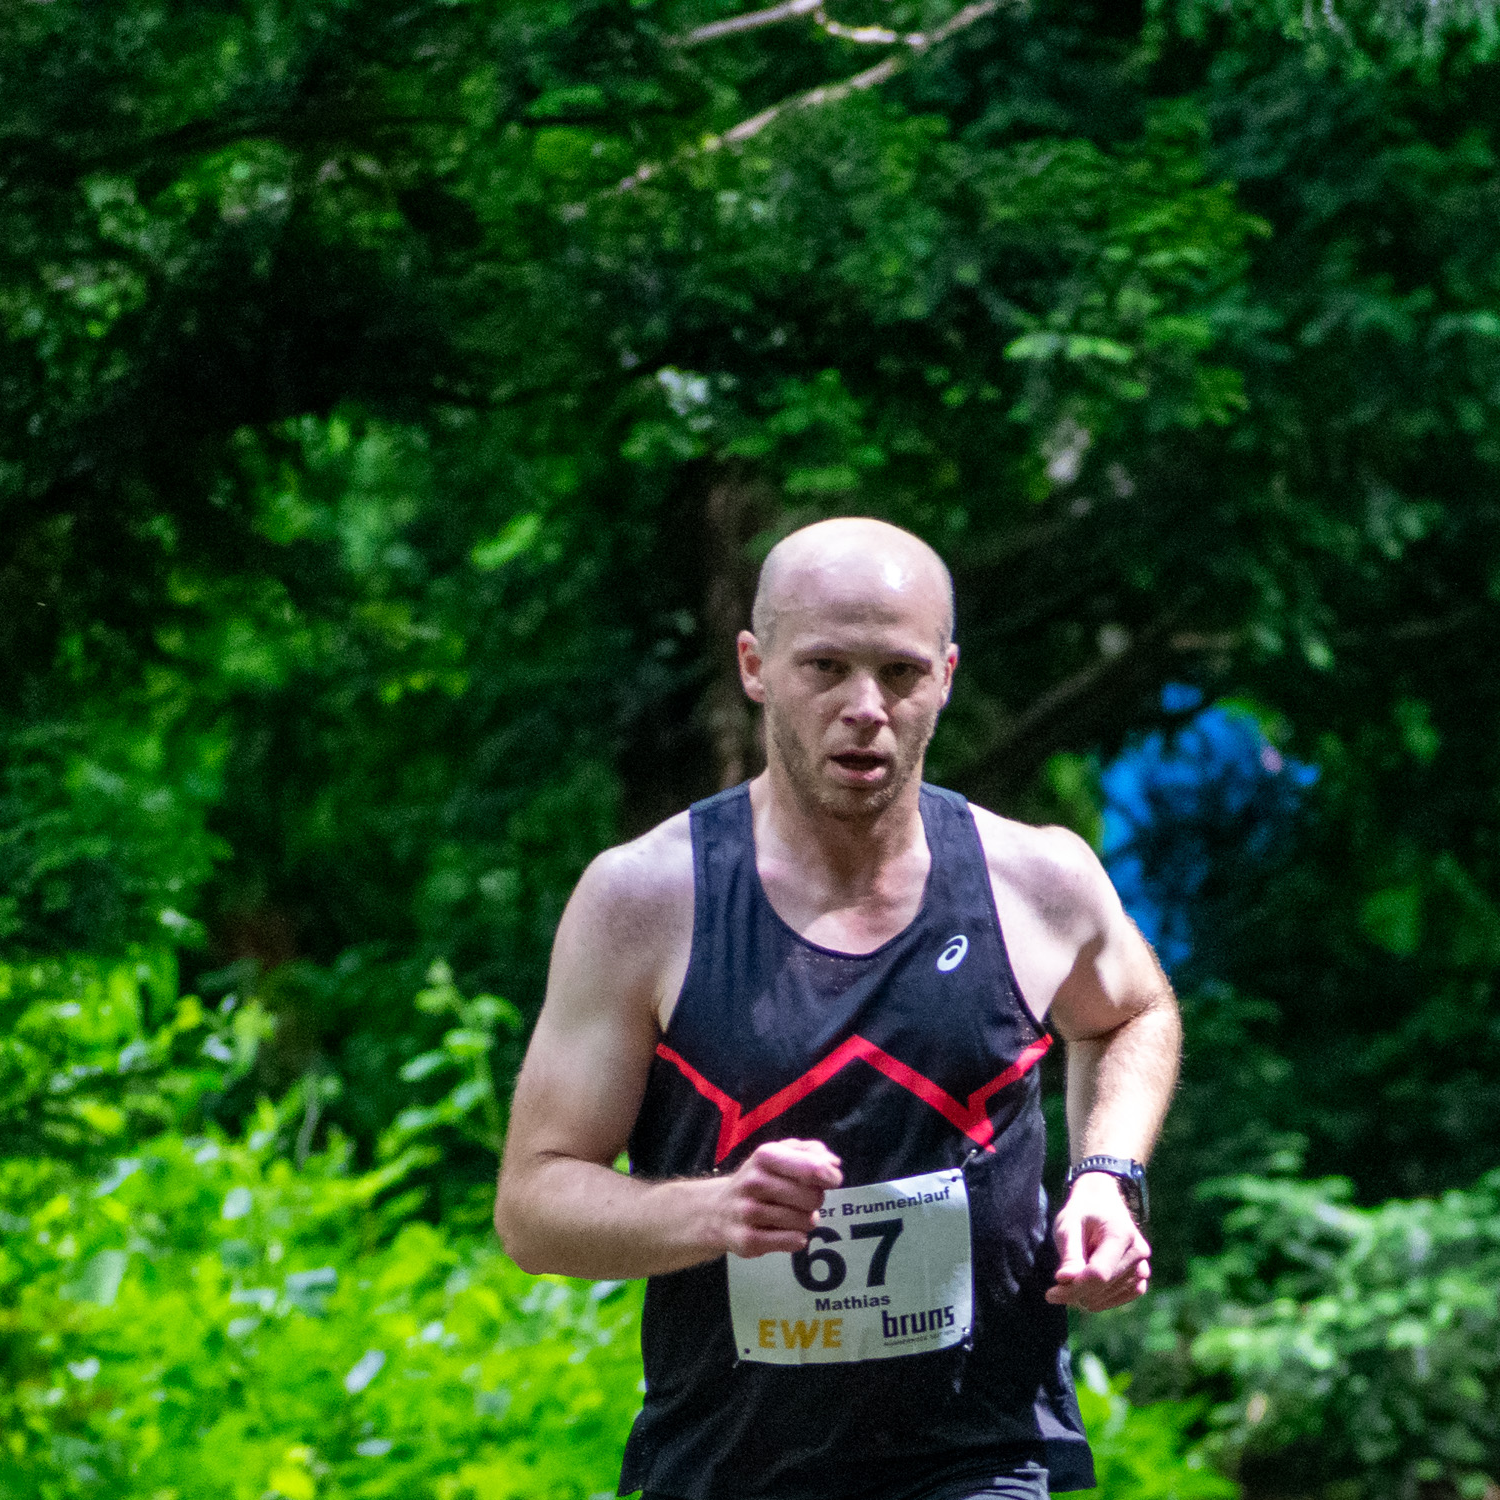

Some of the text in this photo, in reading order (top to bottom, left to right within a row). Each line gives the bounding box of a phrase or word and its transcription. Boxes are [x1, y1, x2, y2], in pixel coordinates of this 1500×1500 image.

[819, 1186, 950, 1218] er Brunnenlauf
[791, 1218, 904, 1293] 67
[815, 1295, 891, 1312] Mathias
[758, 1318, 843, 1349] EWE
[882, 1305, 955, 1338] bruns
